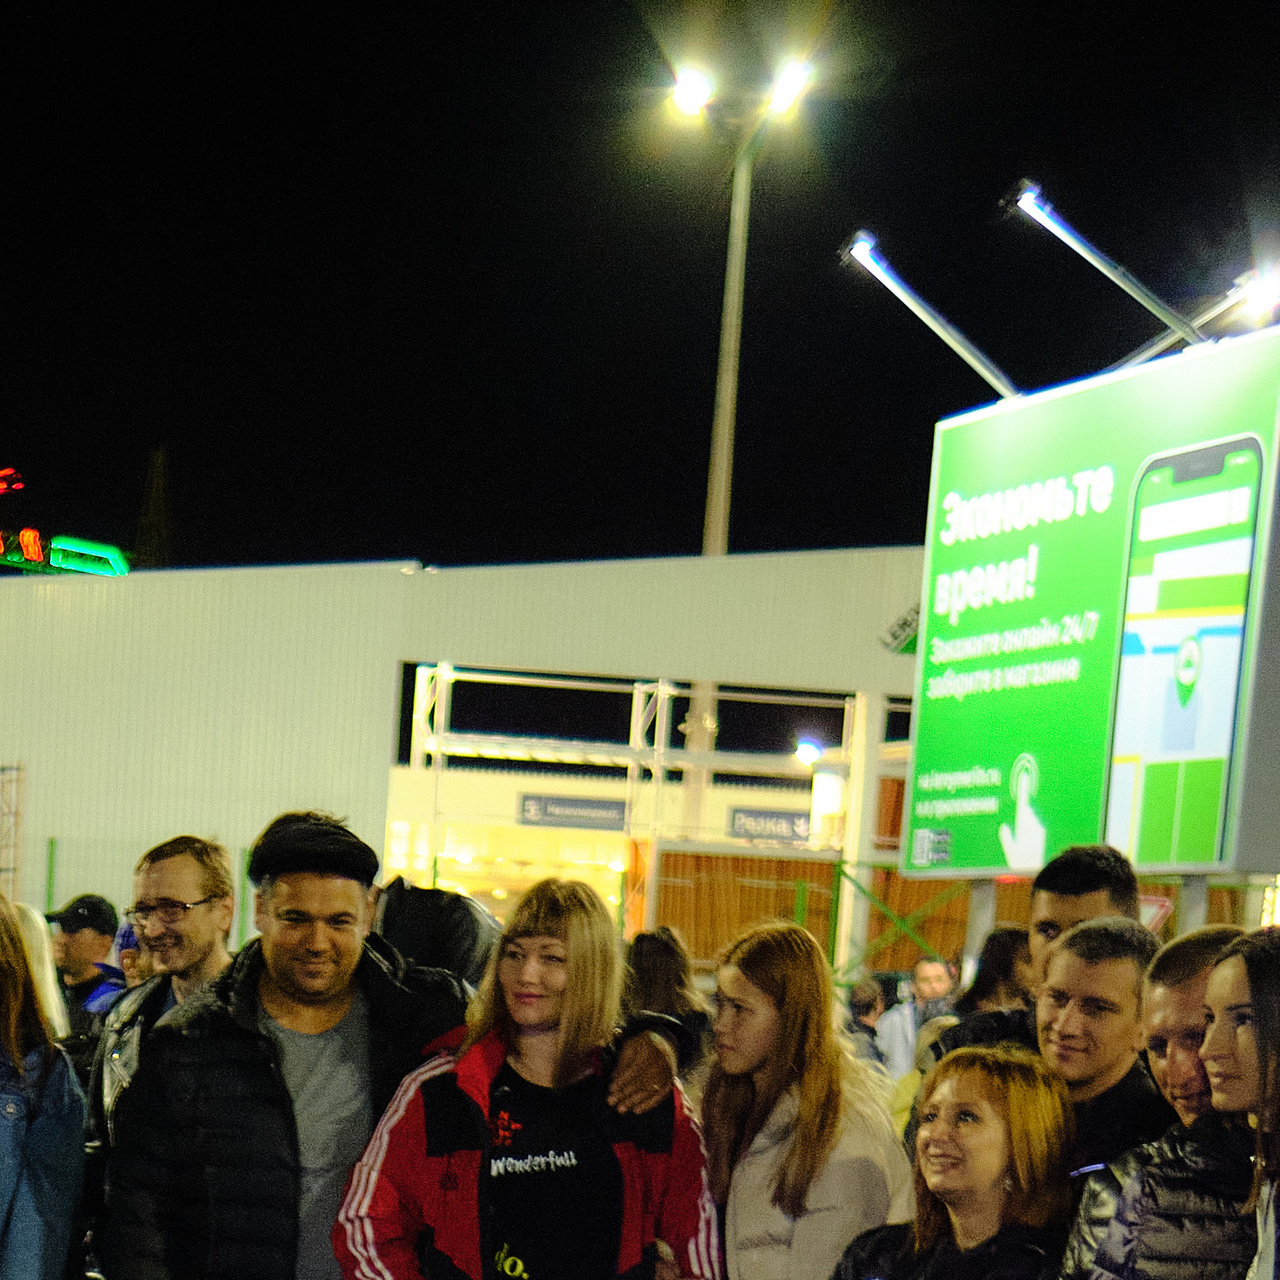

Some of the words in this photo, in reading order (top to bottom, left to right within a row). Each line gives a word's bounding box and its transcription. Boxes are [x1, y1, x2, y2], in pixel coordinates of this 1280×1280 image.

[939, 464, 1116, 547] Экономьте
[934, 543, 1039, 627] время!
[1060, 610, 1101, 645] 24/7
